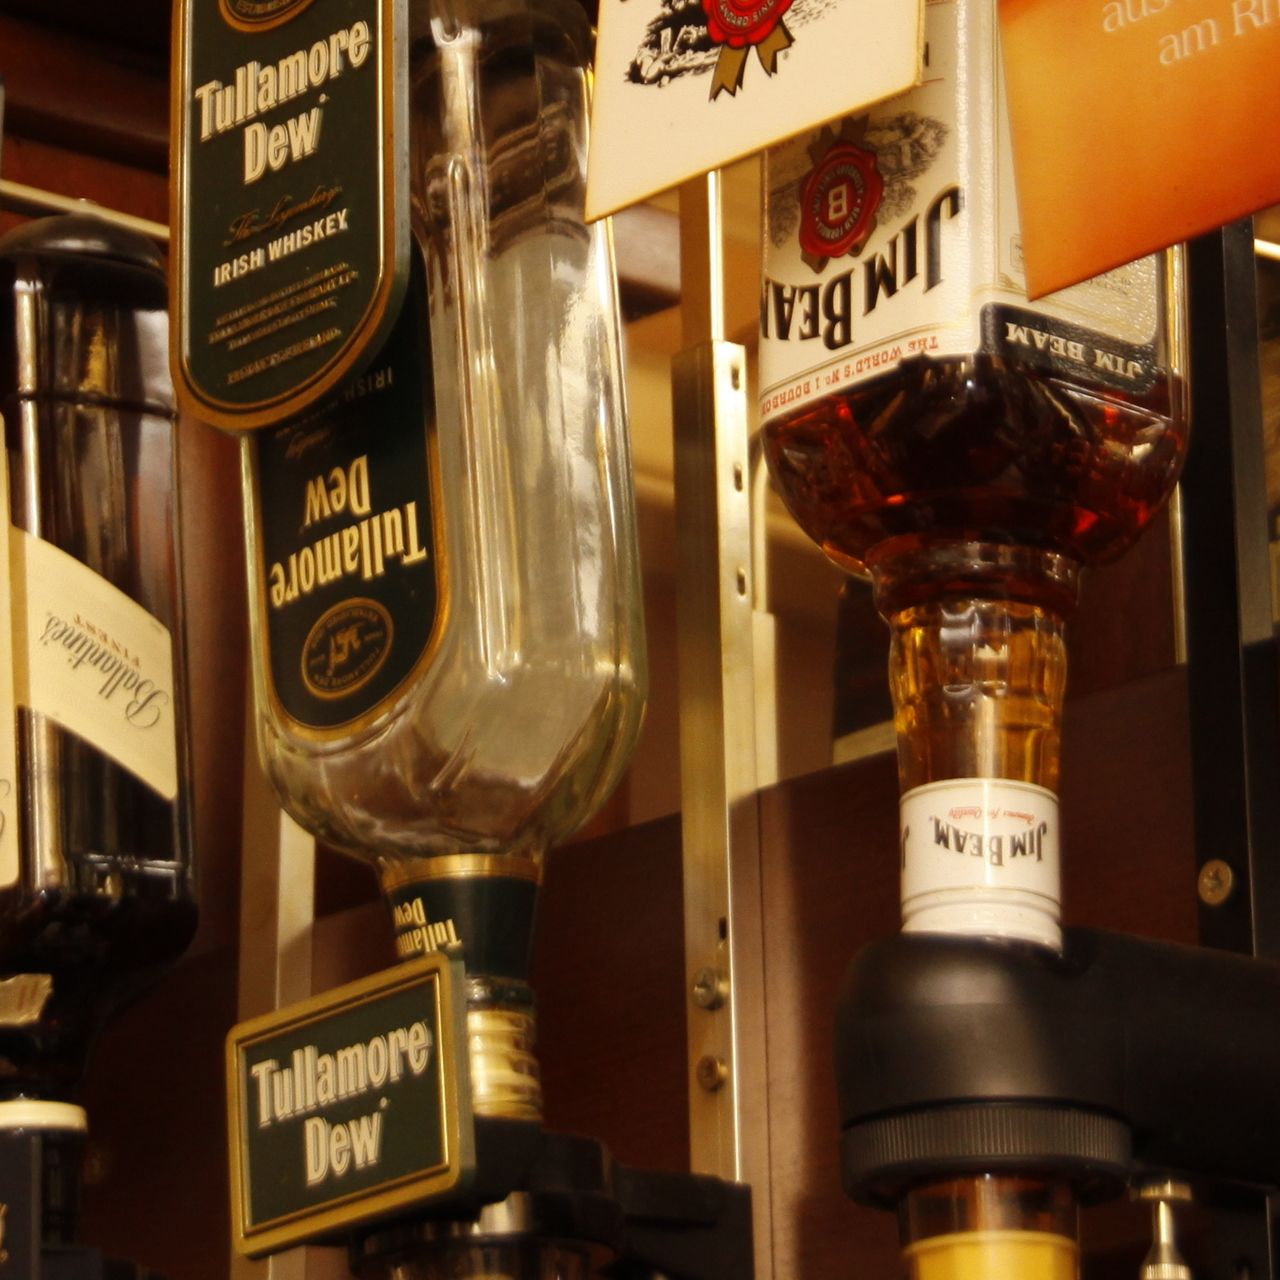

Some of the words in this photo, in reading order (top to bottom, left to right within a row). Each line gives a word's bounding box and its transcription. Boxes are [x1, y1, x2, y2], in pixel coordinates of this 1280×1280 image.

[1158, 18, 1221, 67] am
[195, 19, 371, 140] Tullamore
[243, 107, 322, 186] Dew
[826, 181, 849, 221] B
[213, 247, 266, 288] IRISH
[267, 207, 350, 262] WHISKEY
[862, 184, 966, 317] JIM
[844, 342, 903, 379] WORLD'S
[907, 334, 939, 354] THE
[1004, 322, 1086, 362] BEAM
[1094, 348, 1144, 380] JIM
[303, 453, 372, 527] Dew
[269, 500, 429, 609] Tullamore
[40, 614, 170, 730] Ballantine's
[932, 816, 1005, 867] BEAM
[1009, 820, 1048, 862] JIM
[393, 897, 427, 926] Dew
[251, 1020, 433, 1128] Tullamore
[304, 1108, 384, 1187] Dew
